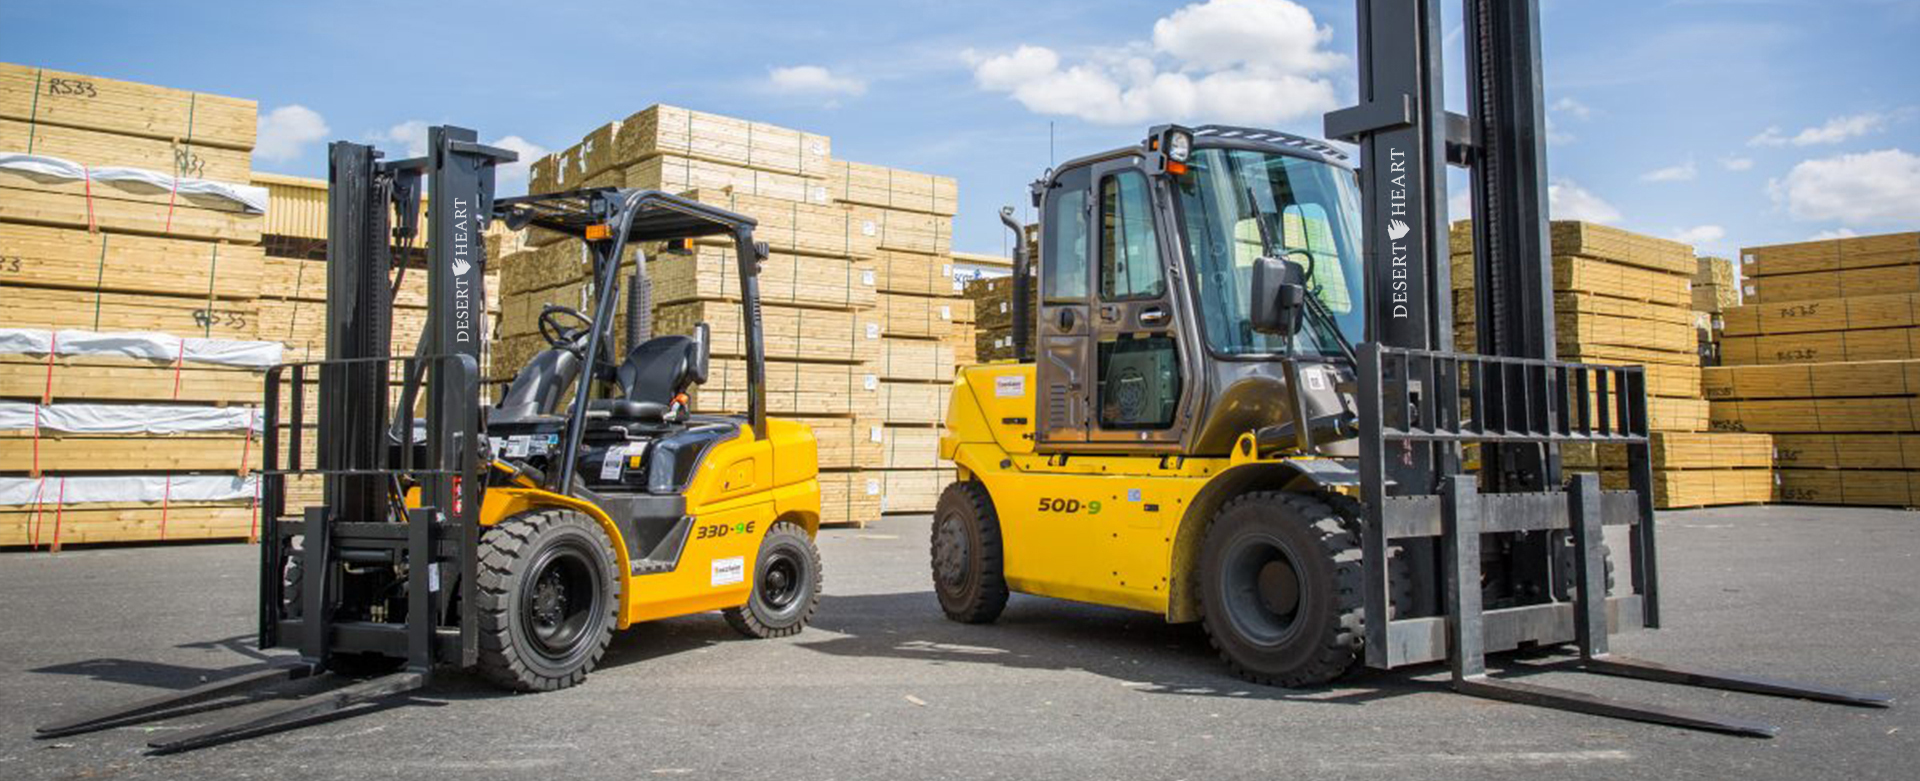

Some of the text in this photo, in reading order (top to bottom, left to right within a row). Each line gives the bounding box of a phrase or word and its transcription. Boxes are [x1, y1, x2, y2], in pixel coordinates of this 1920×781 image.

[50, 78, 97, 98] RS33
[454, 197, 470, 343] DESERT HEART
[1390, 147, 1408, 319] DESERT HEART
[696, 520, 755, 540] 33D-9E
